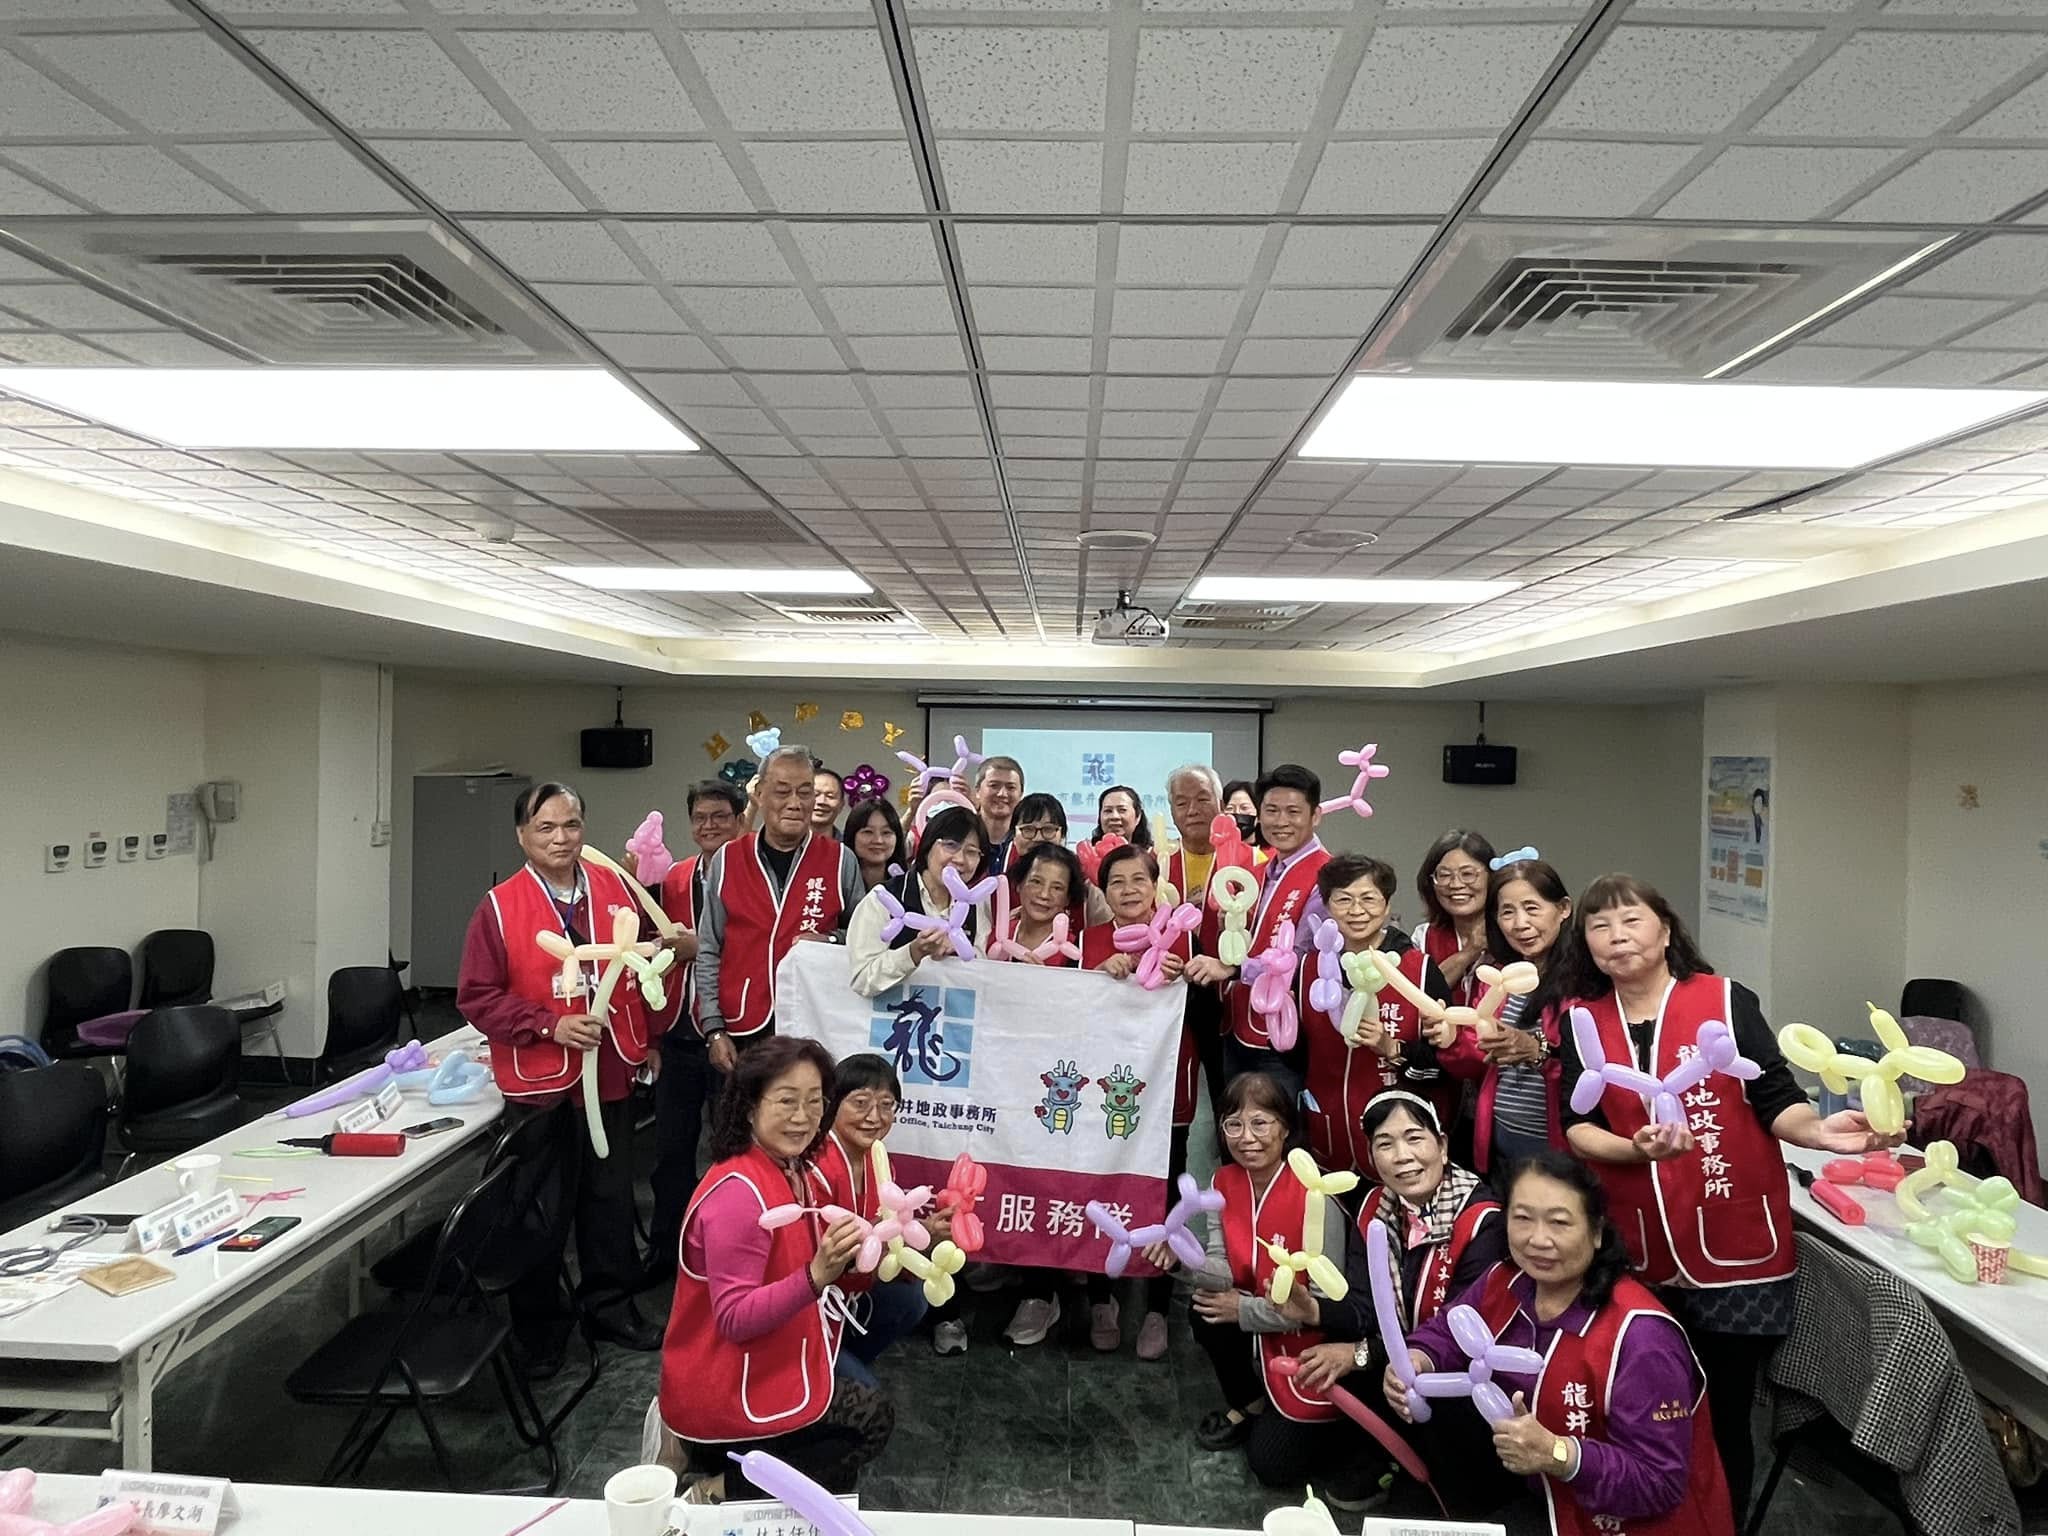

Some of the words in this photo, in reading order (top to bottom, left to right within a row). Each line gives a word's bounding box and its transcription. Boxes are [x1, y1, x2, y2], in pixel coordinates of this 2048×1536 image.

[800, 877, 826, 934] 龍井地政
[894, 1098, 997, 1123] 井地政事務所
[900, 1116, 930, 1128] Office,
[932, 1120, 974, 1132] Taichung
[976, 1123, 995, 1135] City
[1676, 1044, 1733, 1199] 地政事務所
